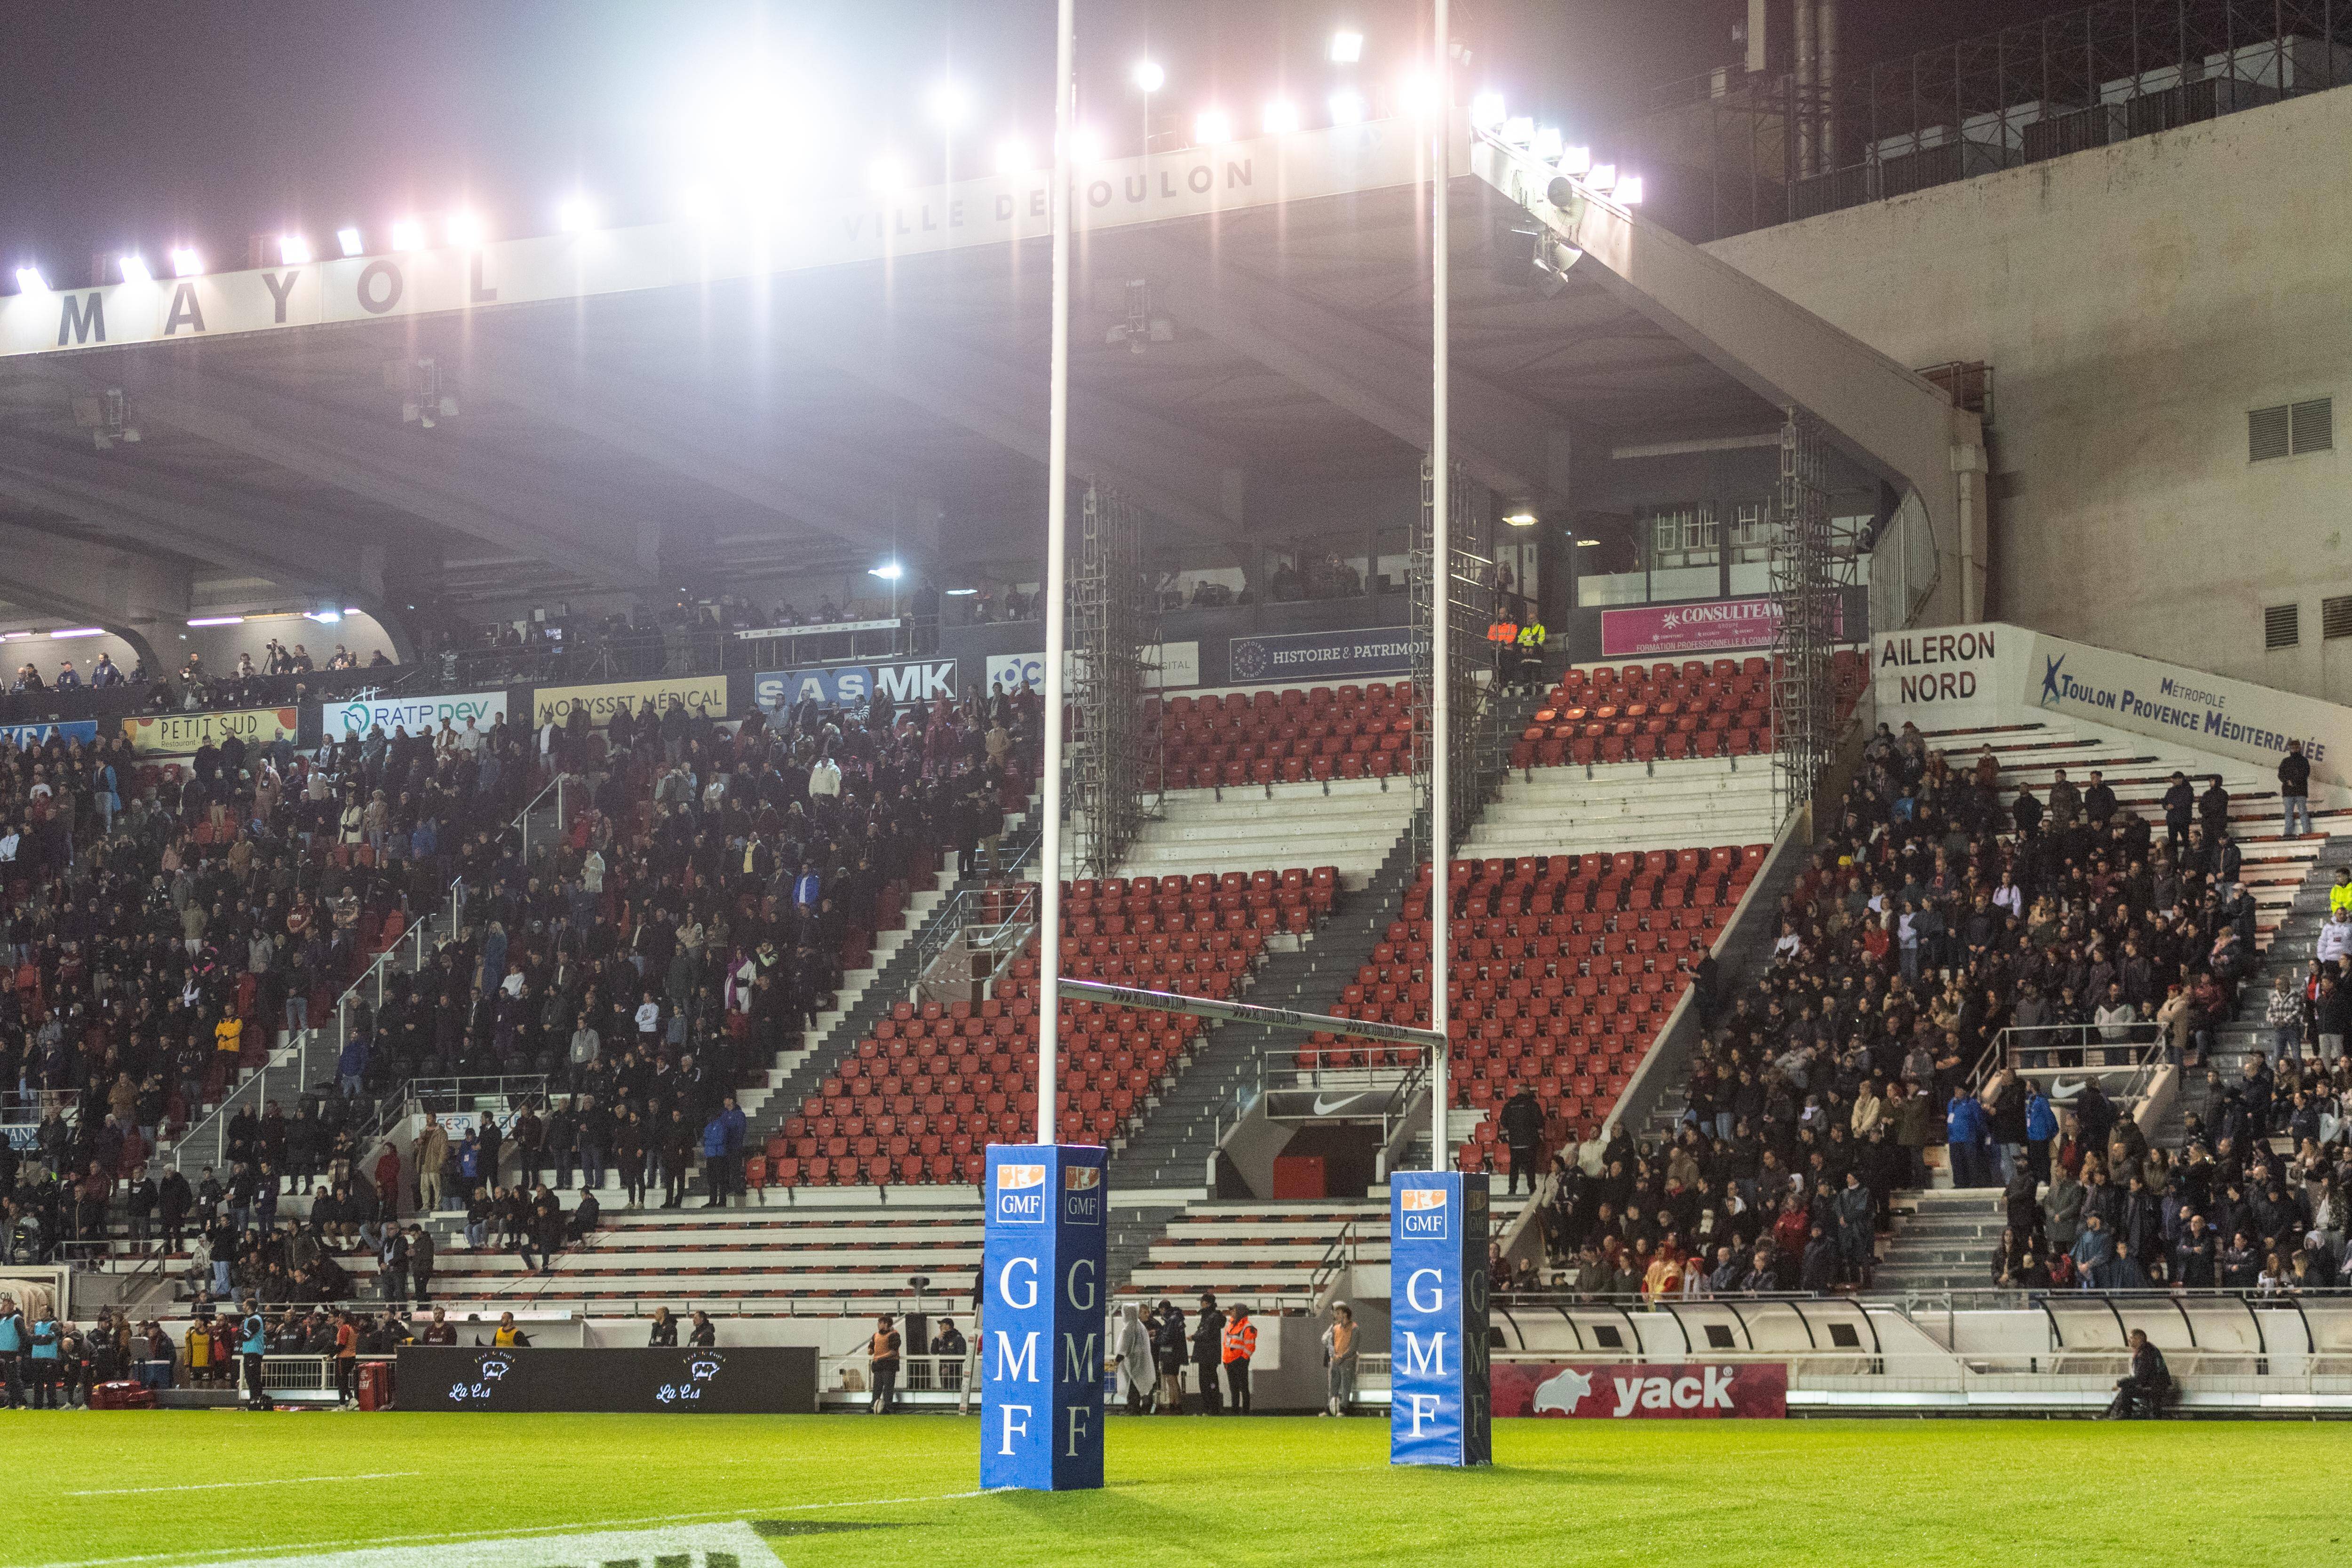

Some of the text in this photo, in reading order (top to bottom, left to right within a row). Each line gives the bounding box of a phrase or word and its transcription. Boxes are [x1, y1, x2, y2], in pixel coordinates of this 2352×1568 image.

[843, 159, 1252, 241] VILLE DE OULON
[58, 249, 497, 347] MAYOL
[1236, 641, 1265, 653] HISTOIRE
[1636, 641, 1676, 653] FORMATION
[1677, 637, 1740, 649] PROFESSIONNELLE
[1881, 631, 1994, 667] AILERON
[1273, 647, 1341, 664] HISTOIRE
[1343, 647, 1351, 659] &
[1234, 661, 1267, 678] PATRIMOINE
[758, 662, 955, 706] SAS MK
[1901, 671, 1976, 704] NORD
[375, 705, 434, 726] RATP
[161, 715, 257, 740] PETIT SUD
[161, 739, 196, 748] Restaurant
[1001, 1194, 1040, 1214] GMF
[1068, 1196, 1097, 1216] GMF
[1406, 1215, 1442, 1232] GMF
[449, 1382, 469, 1402] La
[656, 1383, 677, 1403] La
